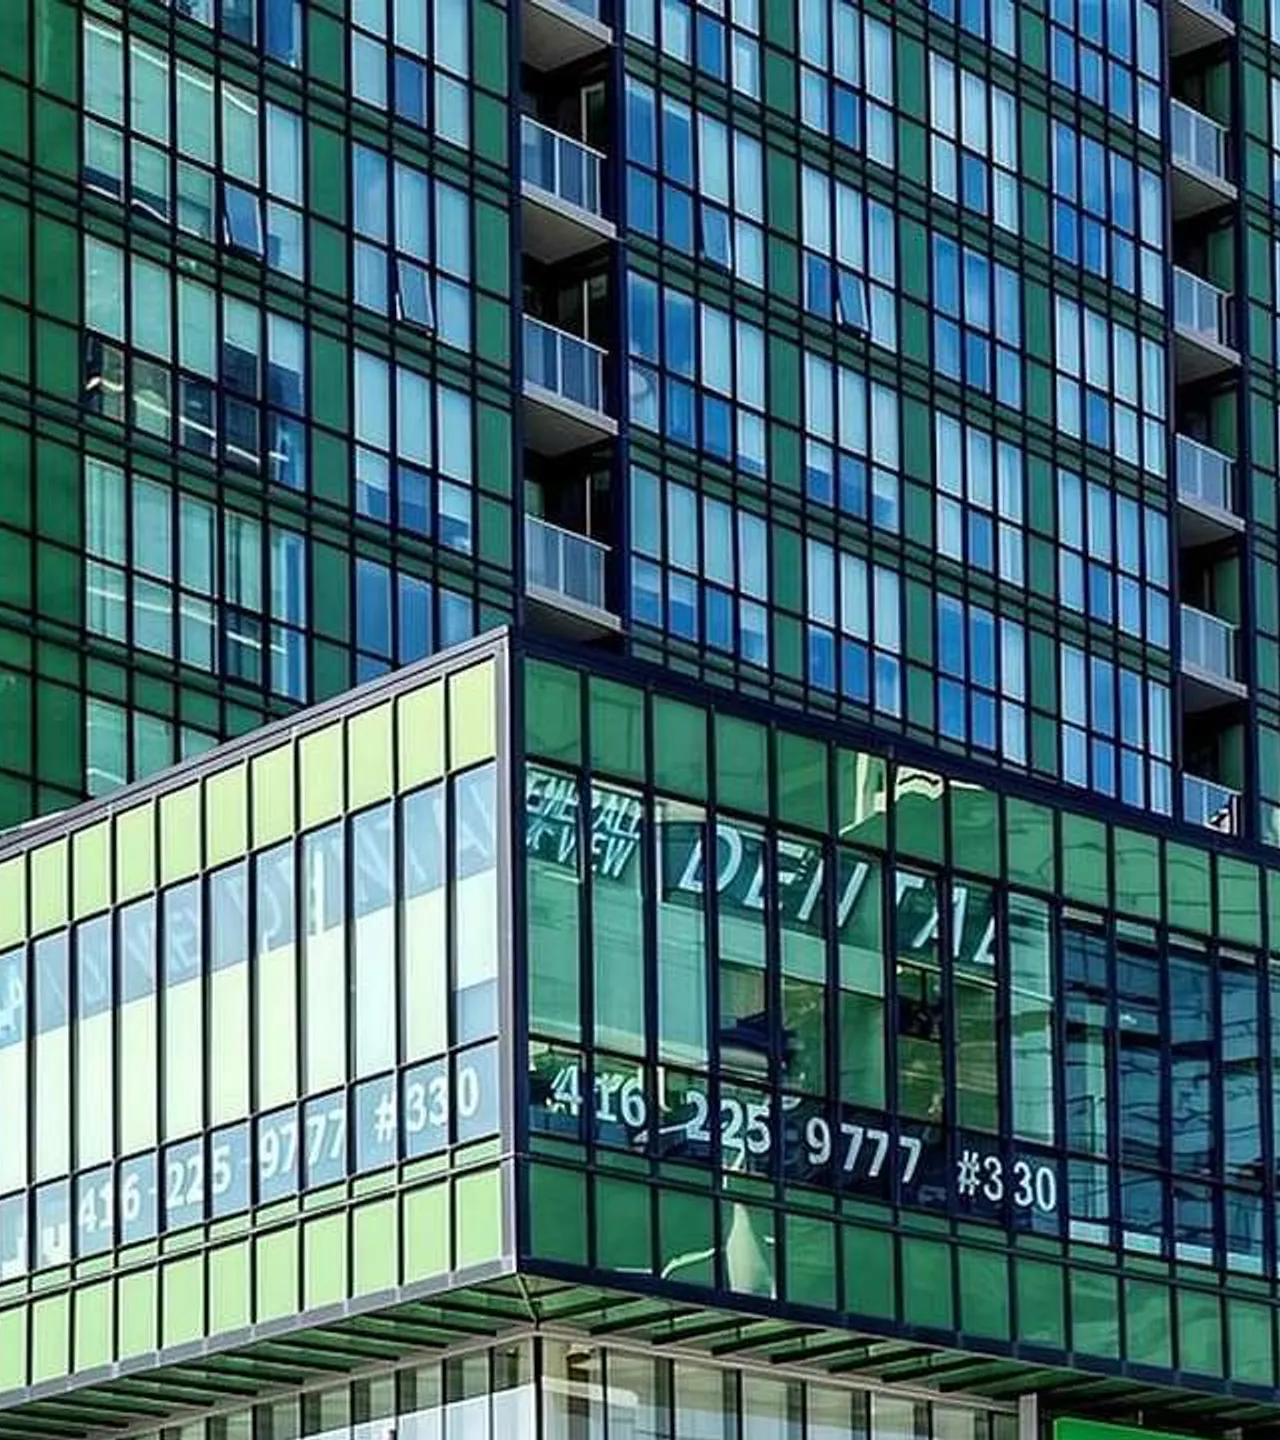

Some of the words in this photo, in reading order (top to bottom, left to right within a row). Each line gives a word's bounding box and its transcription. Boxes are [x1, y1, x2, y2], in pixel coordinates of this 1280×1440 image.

[373, 1067, 480, 1143] #330
[685, 1090, 772, 1153] 225
[807, 1118, 921, 1183] 9777
[956, 1150, 1057, 1211] #330
